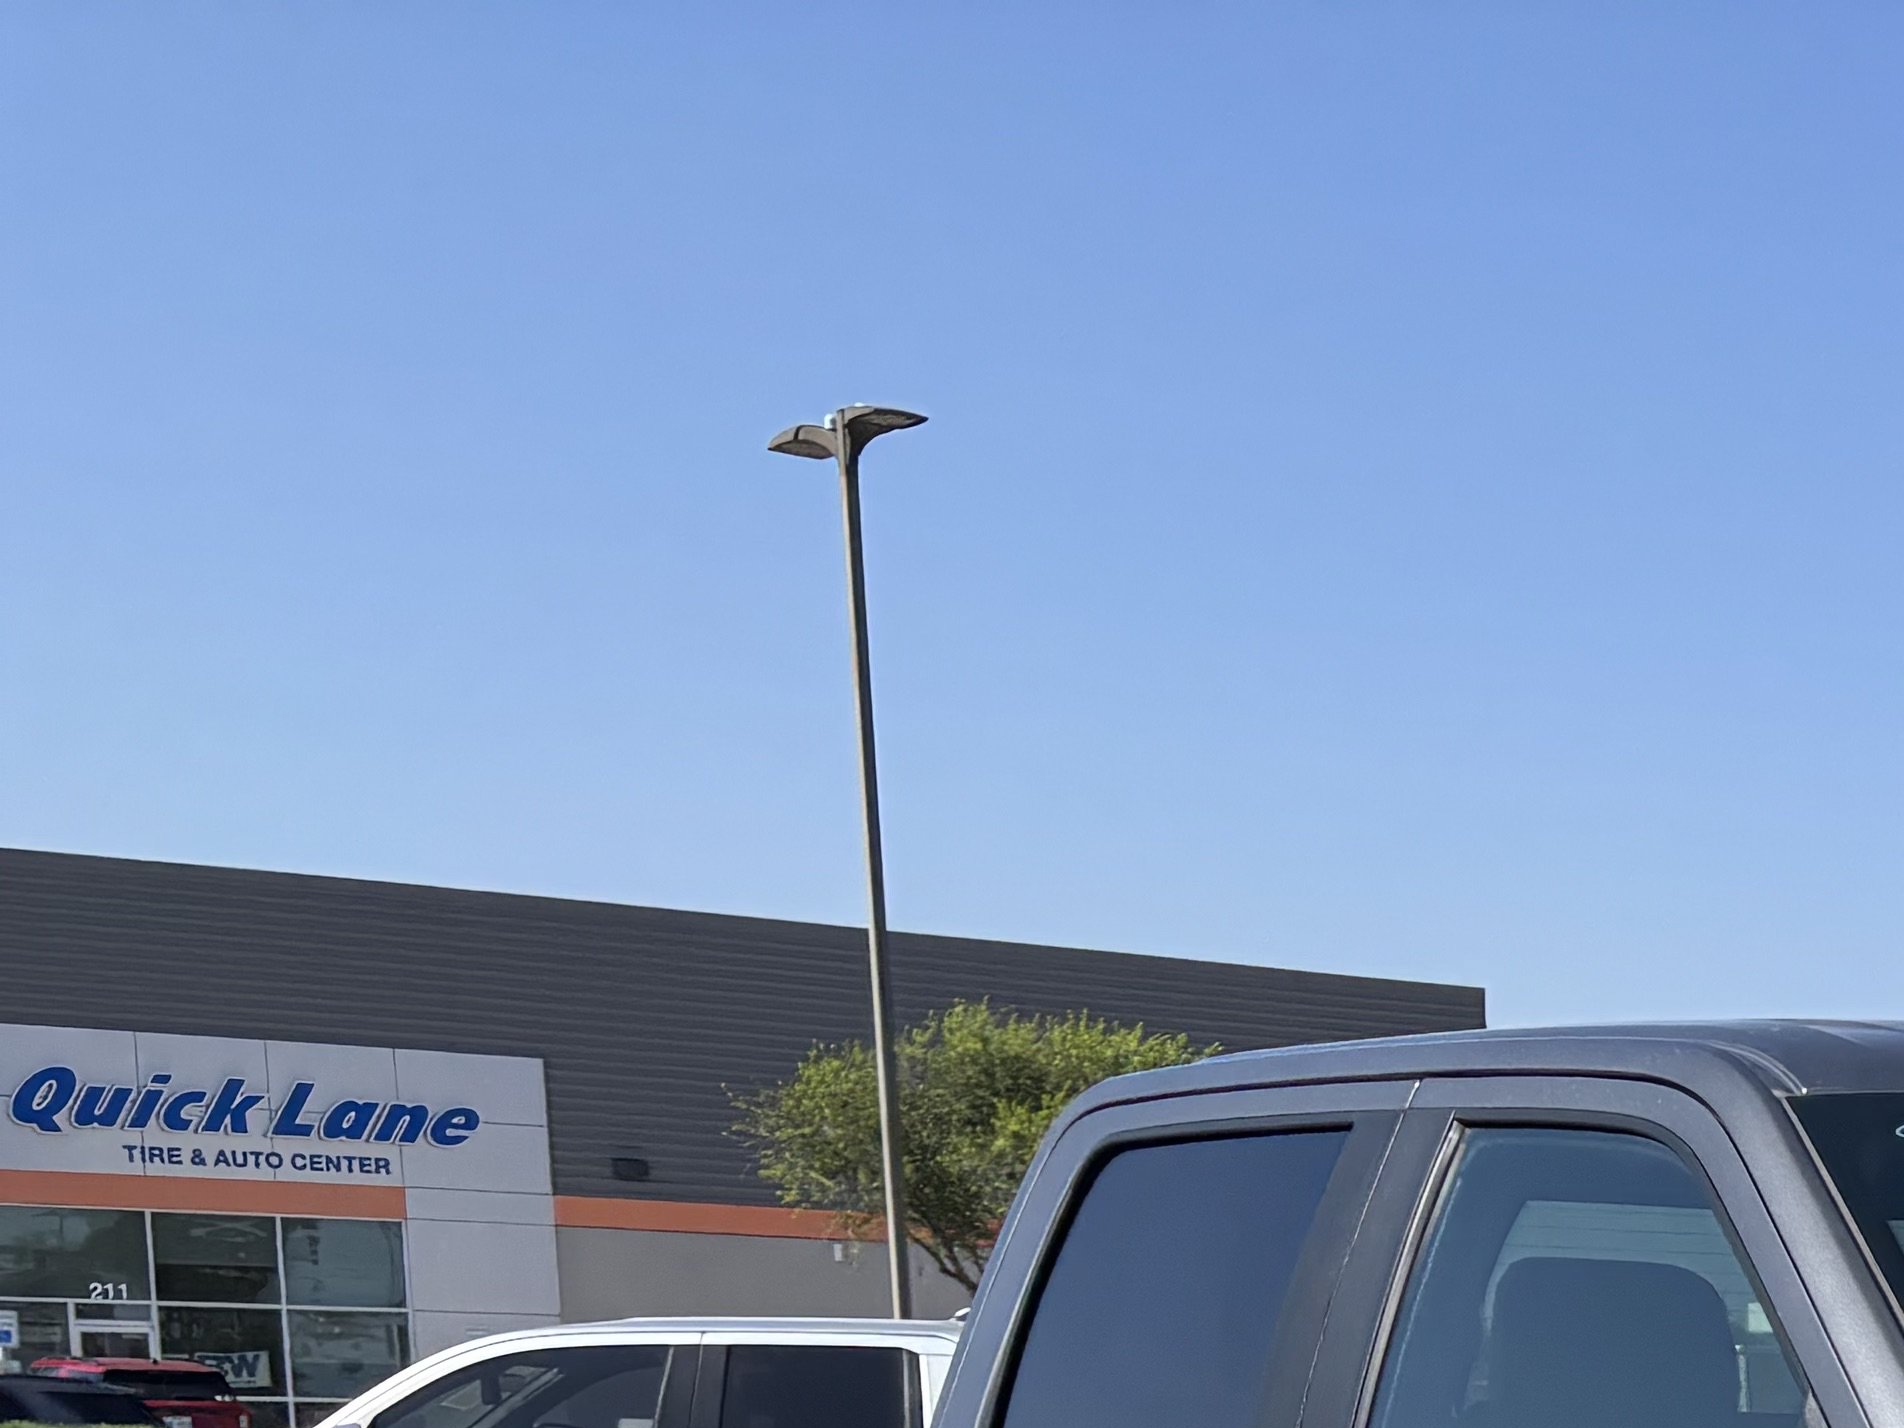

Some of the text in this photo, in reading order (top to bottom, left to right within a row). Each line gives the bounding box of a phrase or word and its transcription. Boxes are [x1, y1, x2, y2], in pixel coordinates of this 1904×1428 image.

[10, 1065, 482, 1148] Quick Lane
[121, 1144, 392, 1176] TIRE & AUTO CENTER
[89, 1281, 128, 1301] 211
